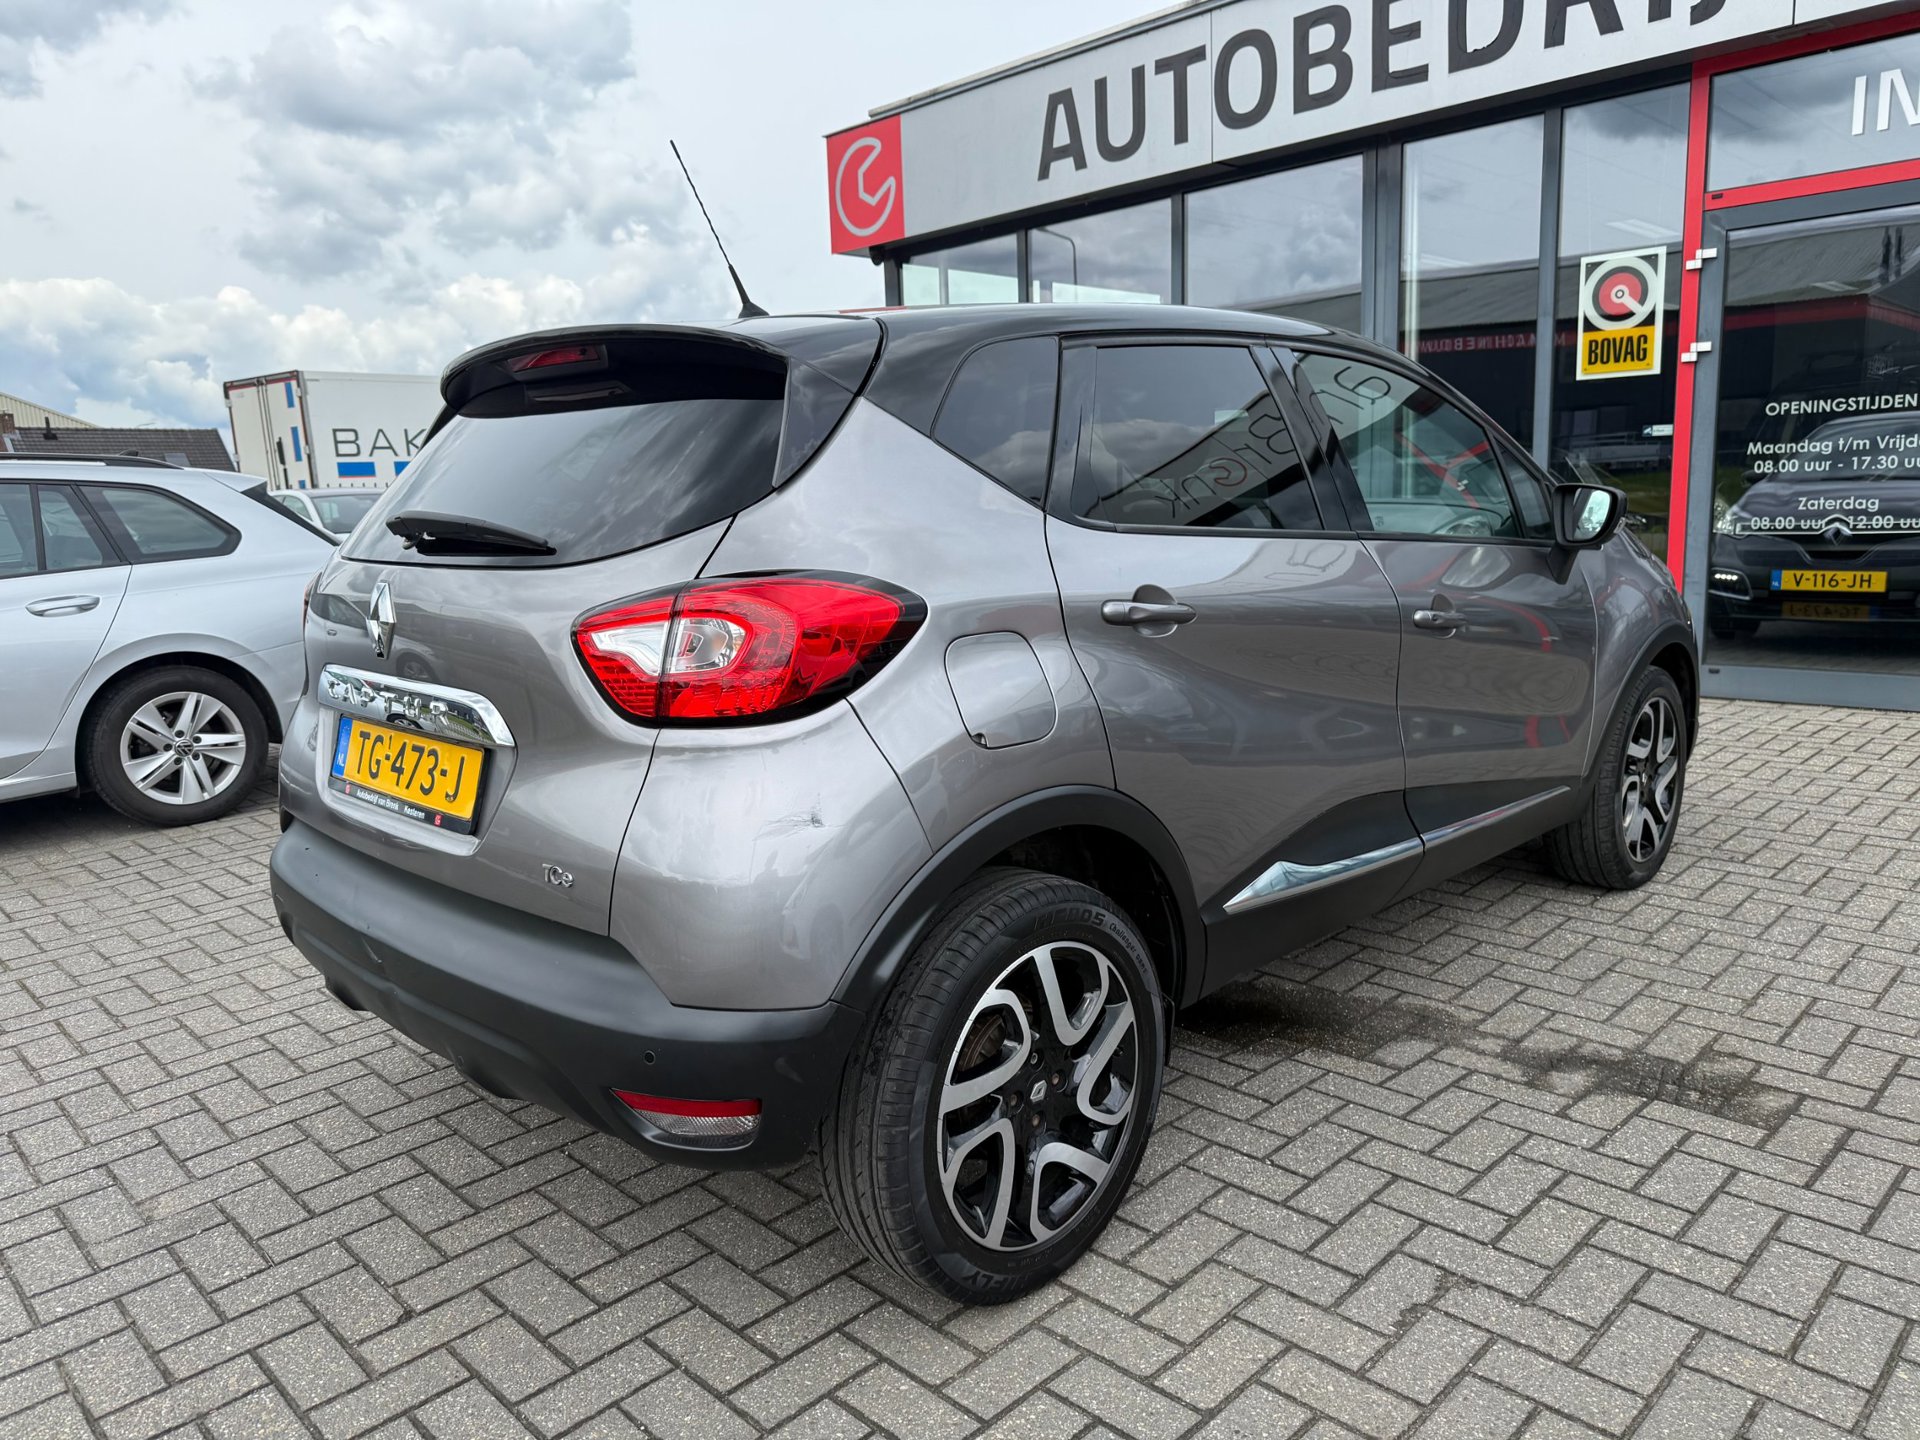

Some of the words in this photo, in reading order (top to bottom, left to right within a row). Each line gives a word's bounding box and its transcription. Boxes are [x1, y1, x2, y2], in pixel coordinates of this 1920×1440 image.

[1037, 0, 1727, 182] AUTOBED
[1587, 334, 1648, 366] BOVAG
[1765, 393, 1918, 416] OPENINGSTIJDEN
[1747, 439, 1833, 455] Maandag
[1838, 436, 1870, 453] t/m
[1876, 433, 1920, 452] Vrijd
[1754, 459, 1799, 474] 08.00
[1804, 460, 1832, 472] uur
[1851, 455, 1899, 470] 17.30
[1797, 496, 1880, 512] Zaterdag
[1750, 516, 1795, 530] 08.00
[1849, 515, 1894, 529] 12.00
[1793, 573, 1872, 589] V-116-JH
[327, 680, 450, 727] CAPTUR
[337, 753, 345, 767] NL
[357, 730, 465, 803] TG-473-J
[542, 863, 574, 888] TCe
